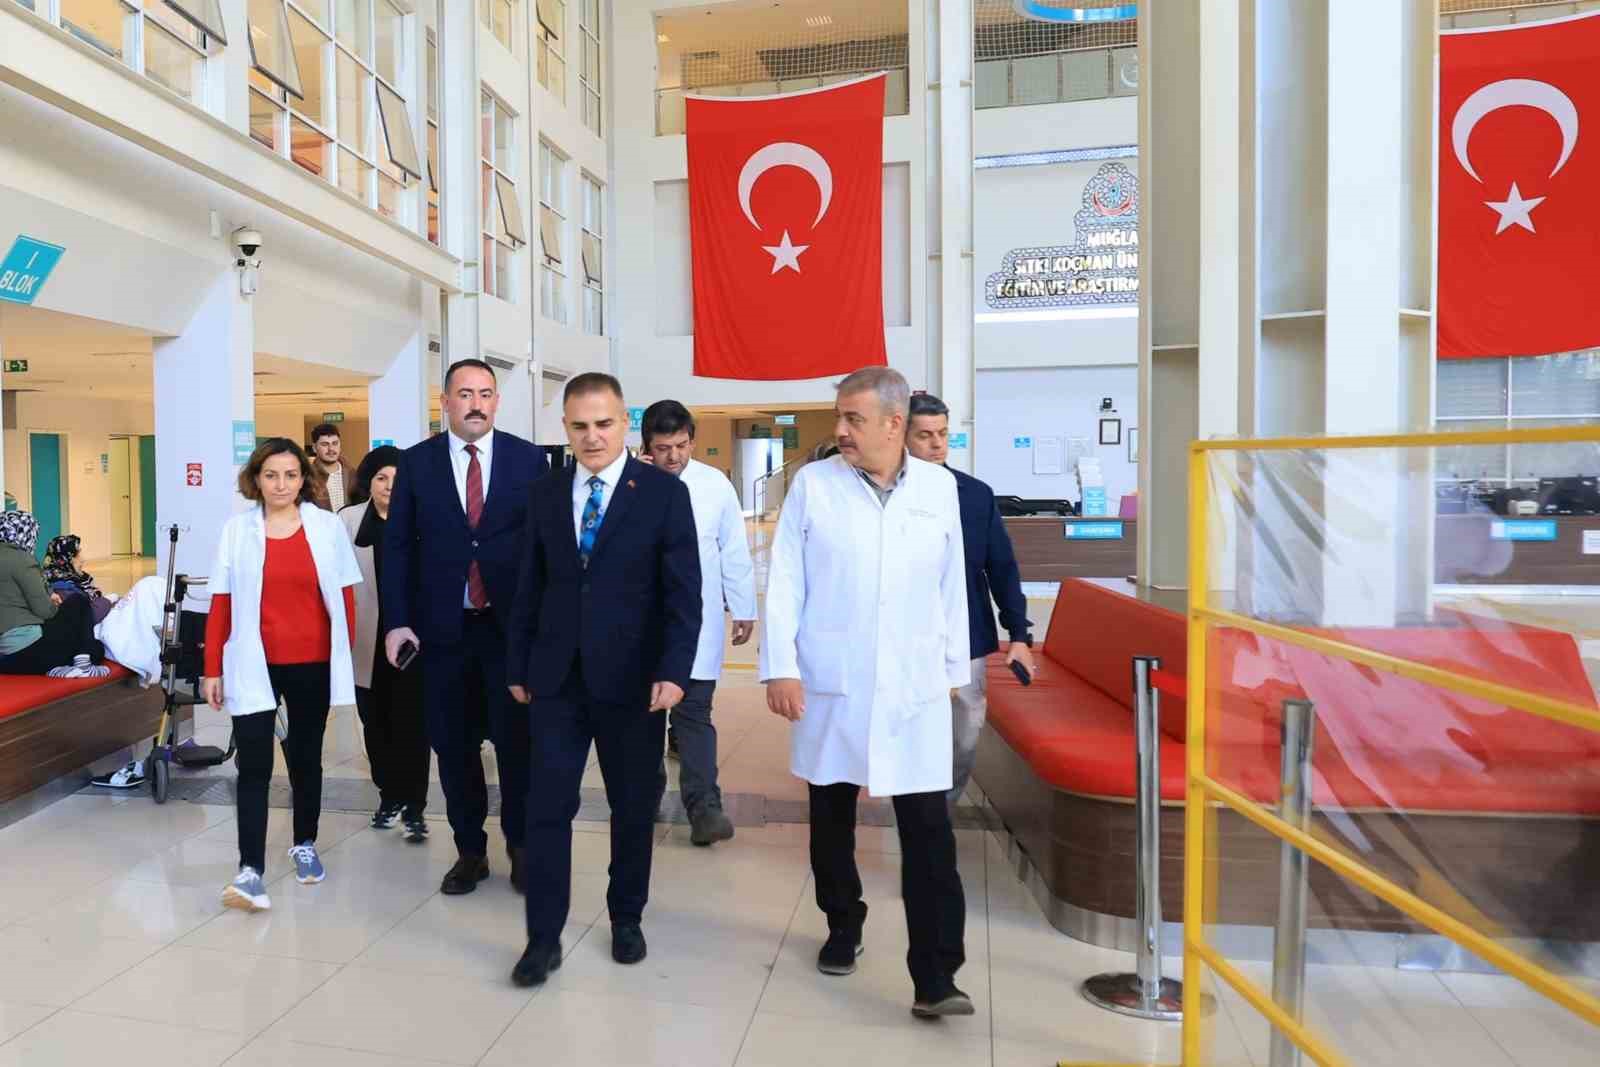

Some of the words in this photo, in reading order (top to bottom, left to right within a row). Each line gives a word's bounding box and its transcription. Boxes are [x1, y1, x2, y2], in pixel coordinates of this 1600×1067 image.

[1087, 229, 1138, 247] MUĞLA
[1054, 254, 1113, 275] KOÇMAN
[0, 270, 40, 294] BLOK
[1048, 279, 1066, 295] VE
